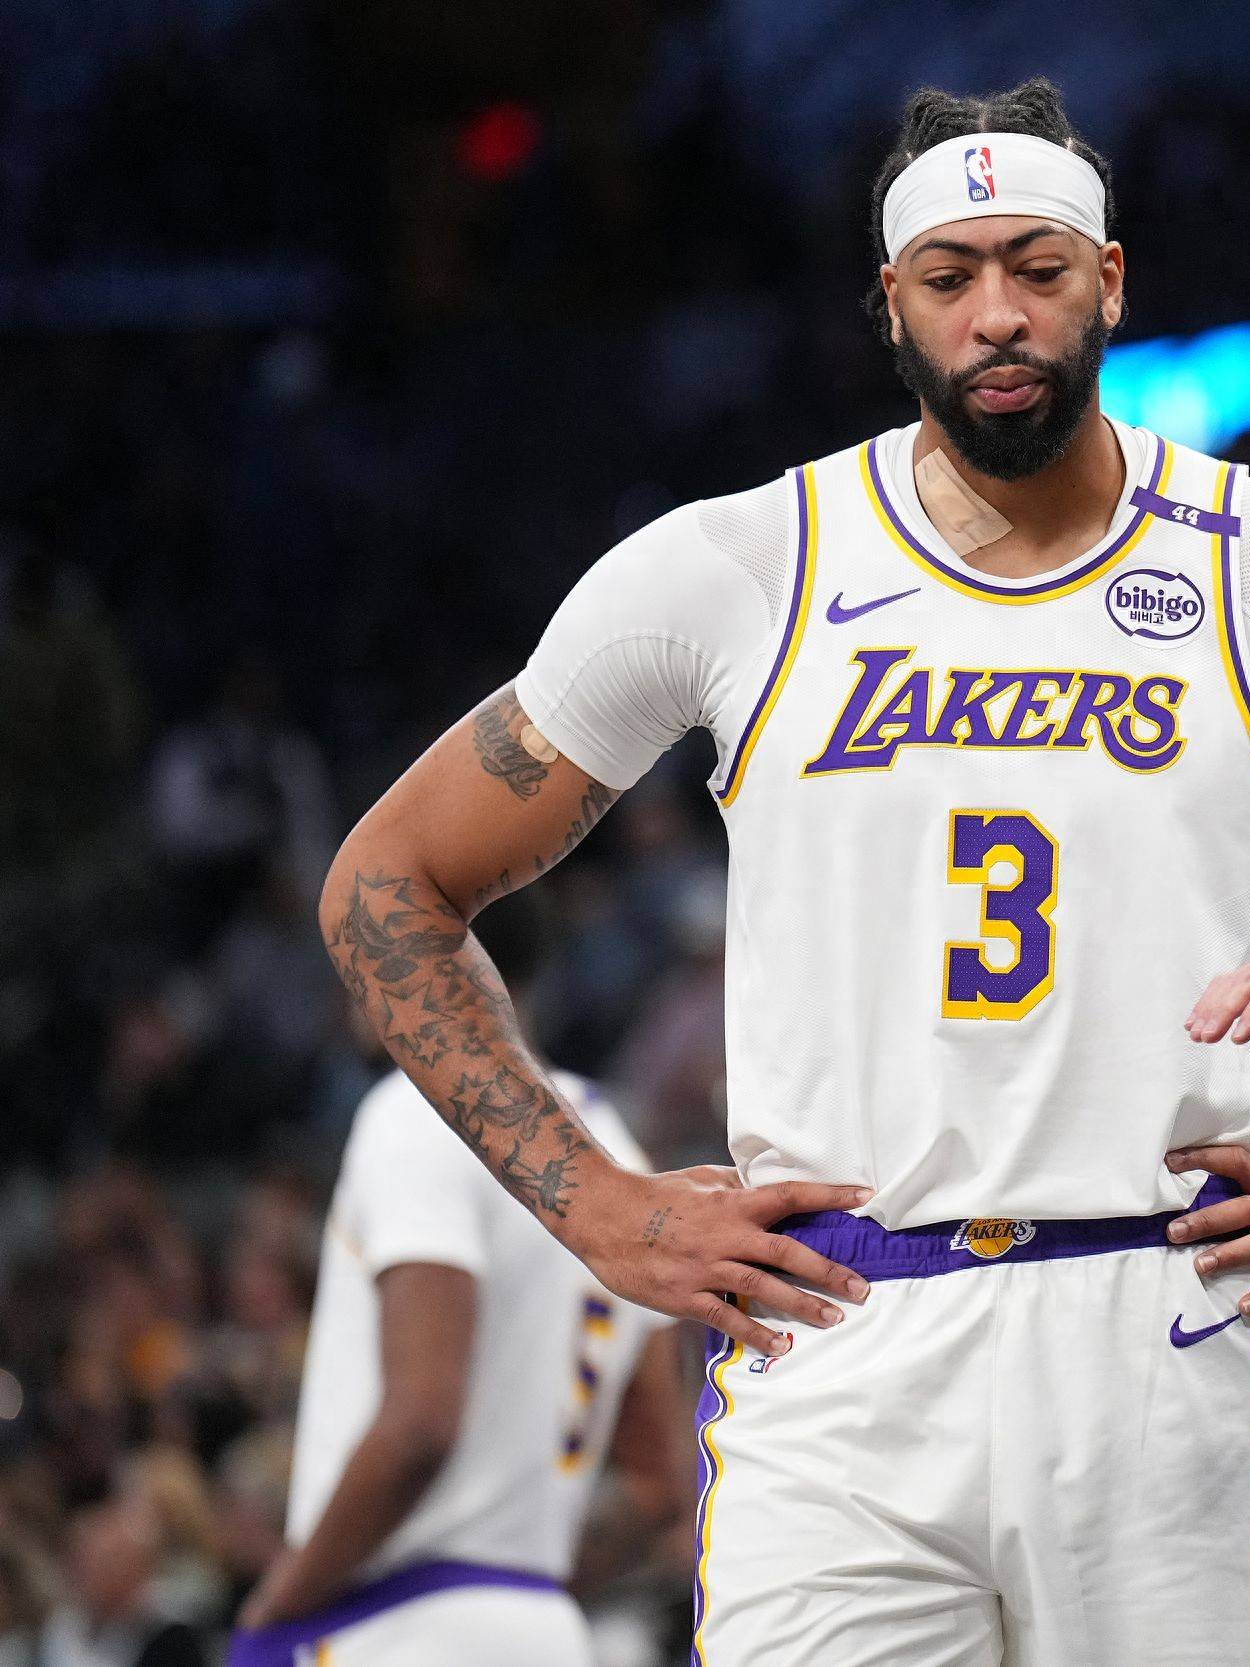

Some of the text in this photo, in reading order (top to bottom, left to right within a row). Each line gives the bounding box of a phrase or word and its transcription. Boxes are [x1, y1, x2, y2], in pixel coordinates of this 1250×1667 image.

[972, 188, 987, 200] NBA
[1171, 505, 1201, 526] 44
[1115, 586, 1199, 622] bibigo
[1129, 610, 1165, 625] 비비고
[798, 645, 1190, 779] LAKERS
[941, 807, 1060, 1022] 3
[949, 1219, 1037, 1250] LAKERS
